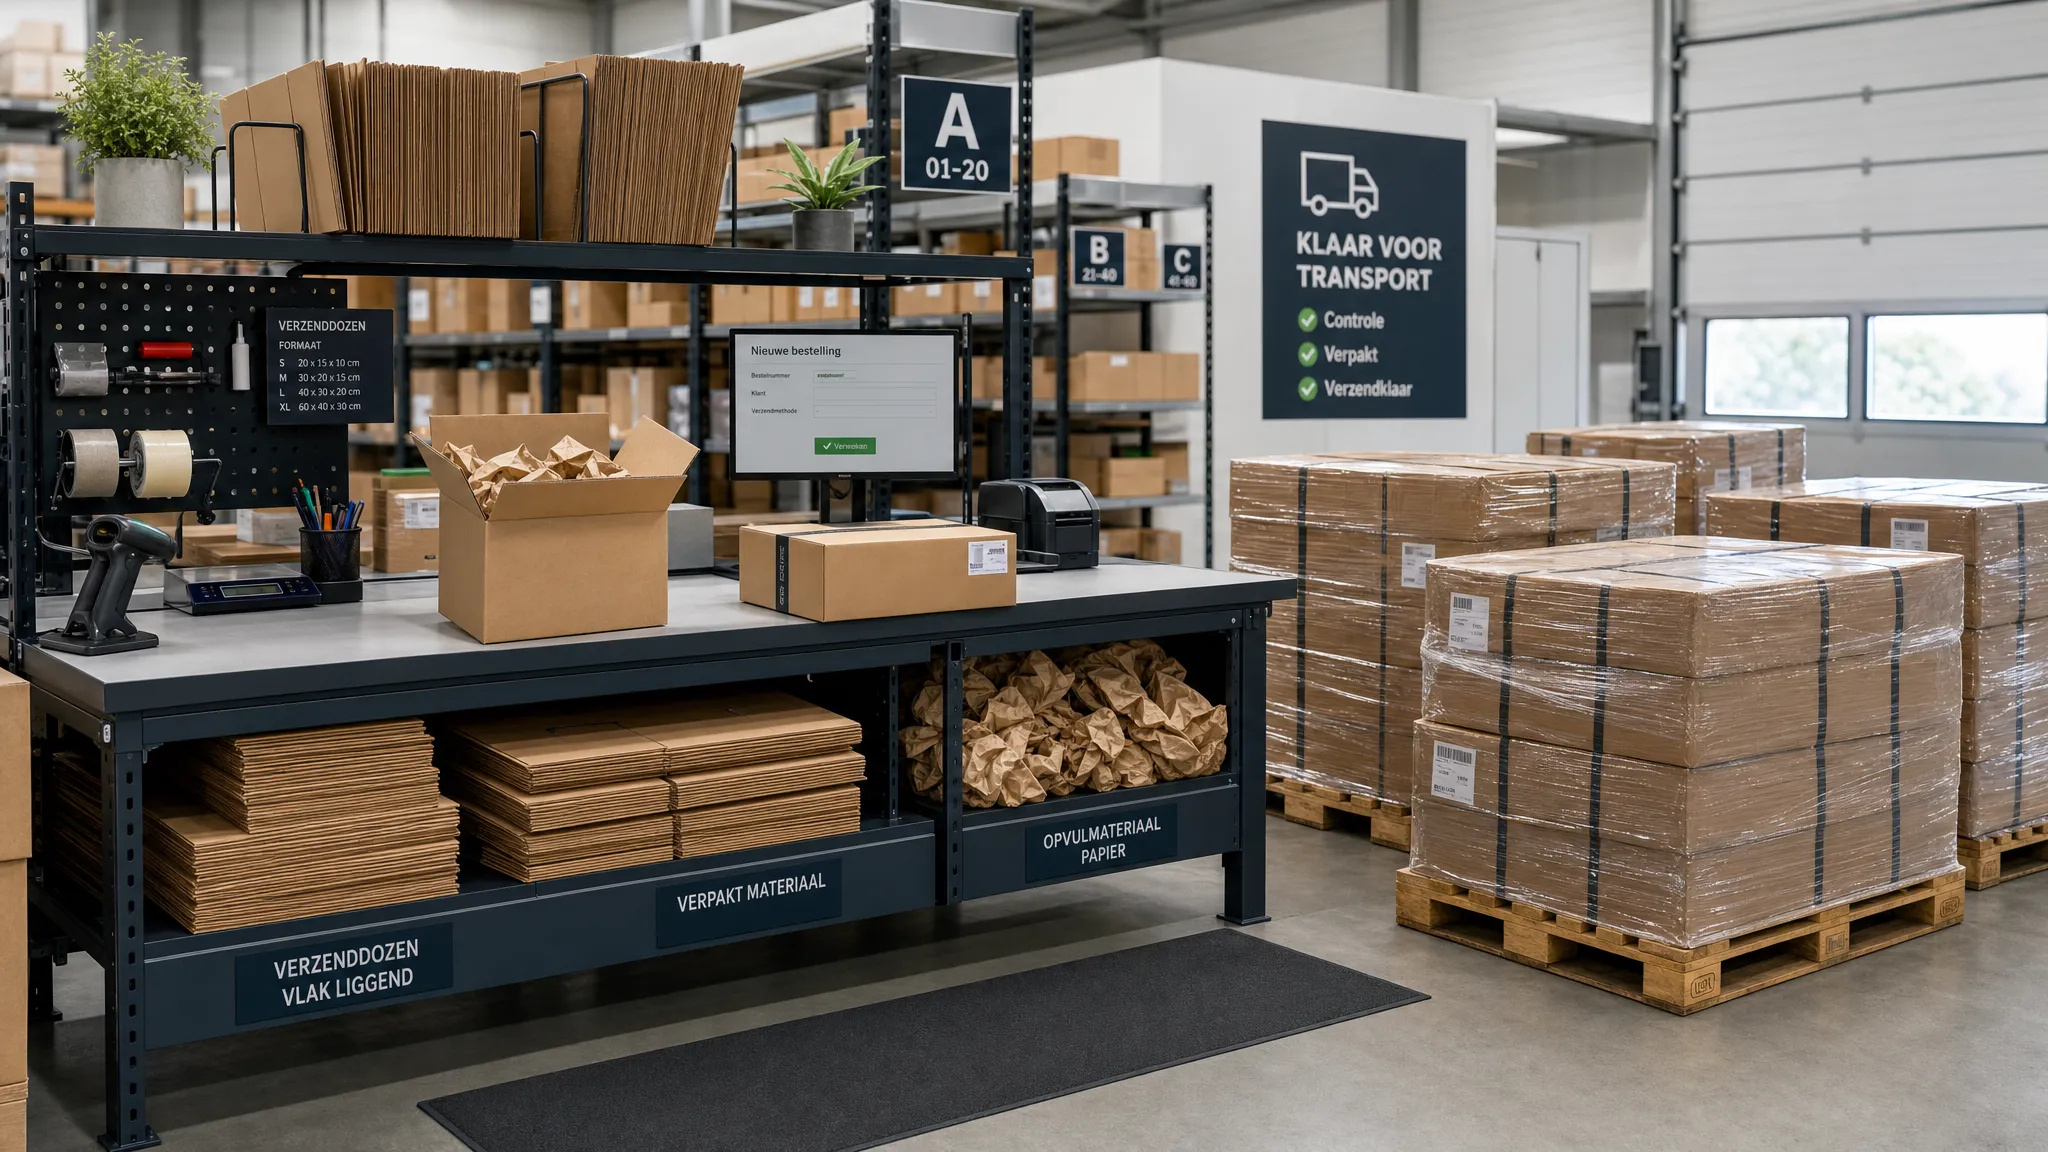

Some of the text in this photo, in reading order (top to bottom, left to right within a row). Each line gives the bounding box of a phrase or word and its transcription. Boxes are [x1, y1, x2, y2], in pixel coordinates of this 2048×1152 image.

[934, 92, 980, 150] A
[925, 156, 989, 182] 01-20
[1089, 235, 1110, 265] B
[1296, 230, 1443, 261] KLAAR VOOR
[1173, 247, 1192, 274] C
[1082, 267, 1118, 282] 21-40
[1296, 264, 1433, 291] TRANSPORT
[278, 320, 366, 332] VERZENDDOZEN
[1323, 310, 1385, 329] Controle
[279, 341, 322, 350] FORMAAT
[751, 346, 841, 358] Nieuwe bestelling
[1323, 345, 1379, 367] Verpakt
[279, 358, 285, 367] S
[298, 358, 308, 367] 20
[317, 358, 326, 367] 15
[336, 358, 346, 367] 10
[279, 374, 287, 382] M
[298, 374, 308, 382] 30
[318, 374, 328, 382] 20
[336, 374, 346, 382] 15
[1323, 379, 1413, 397] Verzendklaar
[280, 388, 285, 396] L
[298, 388, 309, 396] 40
[318, 388, 328, 396] 30
[336, 388, 346, 396] 20
[280, 403, 290, 412] XL
[298, 403, 309, 411] 60
[318, 403, 328, 411] 40
[337, 403, 347, 411] 30
[1043, 816, 1161, 849] OPVULMATERIAAL
[1081, 843, 1126, 865] PAPIER
[677, 872, 827, 913] VERPAKT MATERIAAL
[273, 938, 419, 980] VERZENDDOZEN
[281, 967, 414, 1007] VLAK LIGGEND
